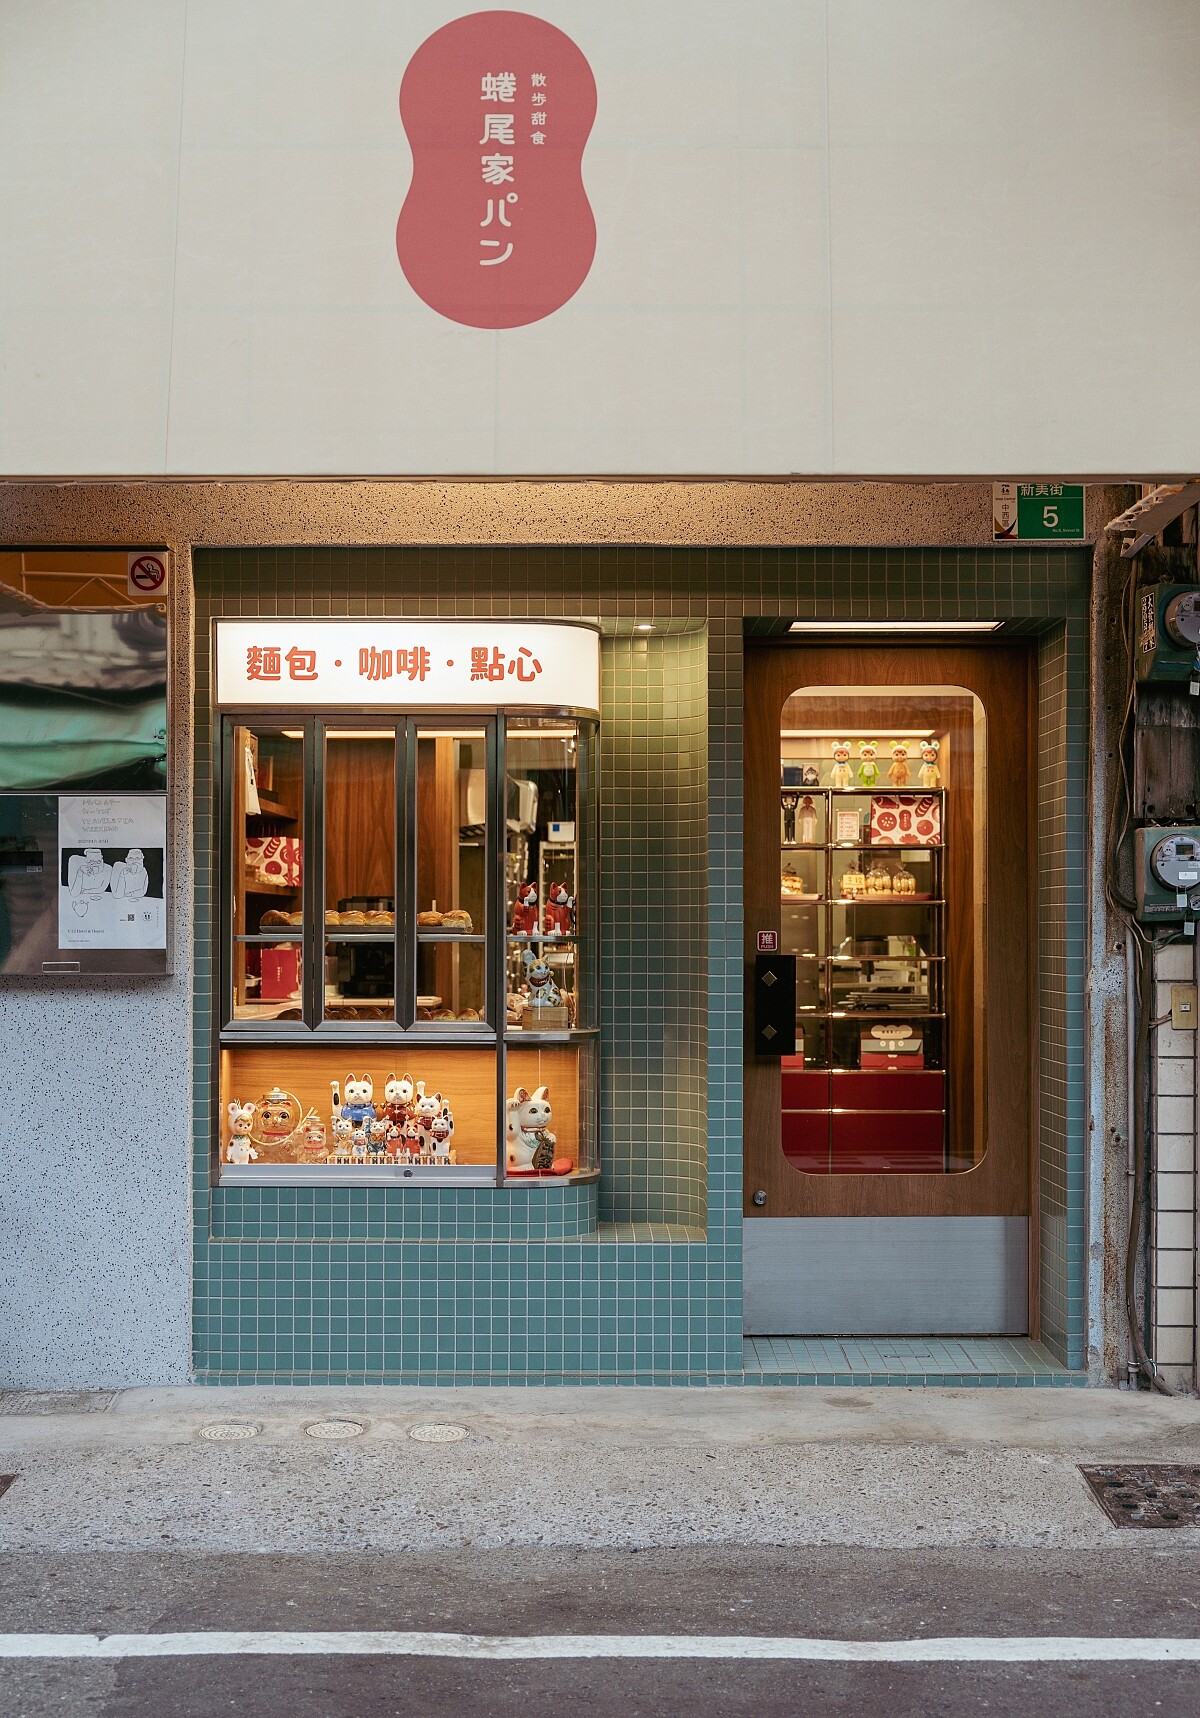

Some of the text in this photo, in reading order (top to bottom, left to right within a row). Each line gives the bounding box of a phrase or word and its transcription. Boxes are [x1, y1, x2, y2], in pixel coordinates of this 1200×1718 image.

[530, 73, 547, 145] 散步甜食
[479, 72, 519, 265] 蜷尾家パン
[1020, 484, 1064, 496] 新美街
[1043, 506, 1059, 527] 5
[761, 933, 774, 945] 推
